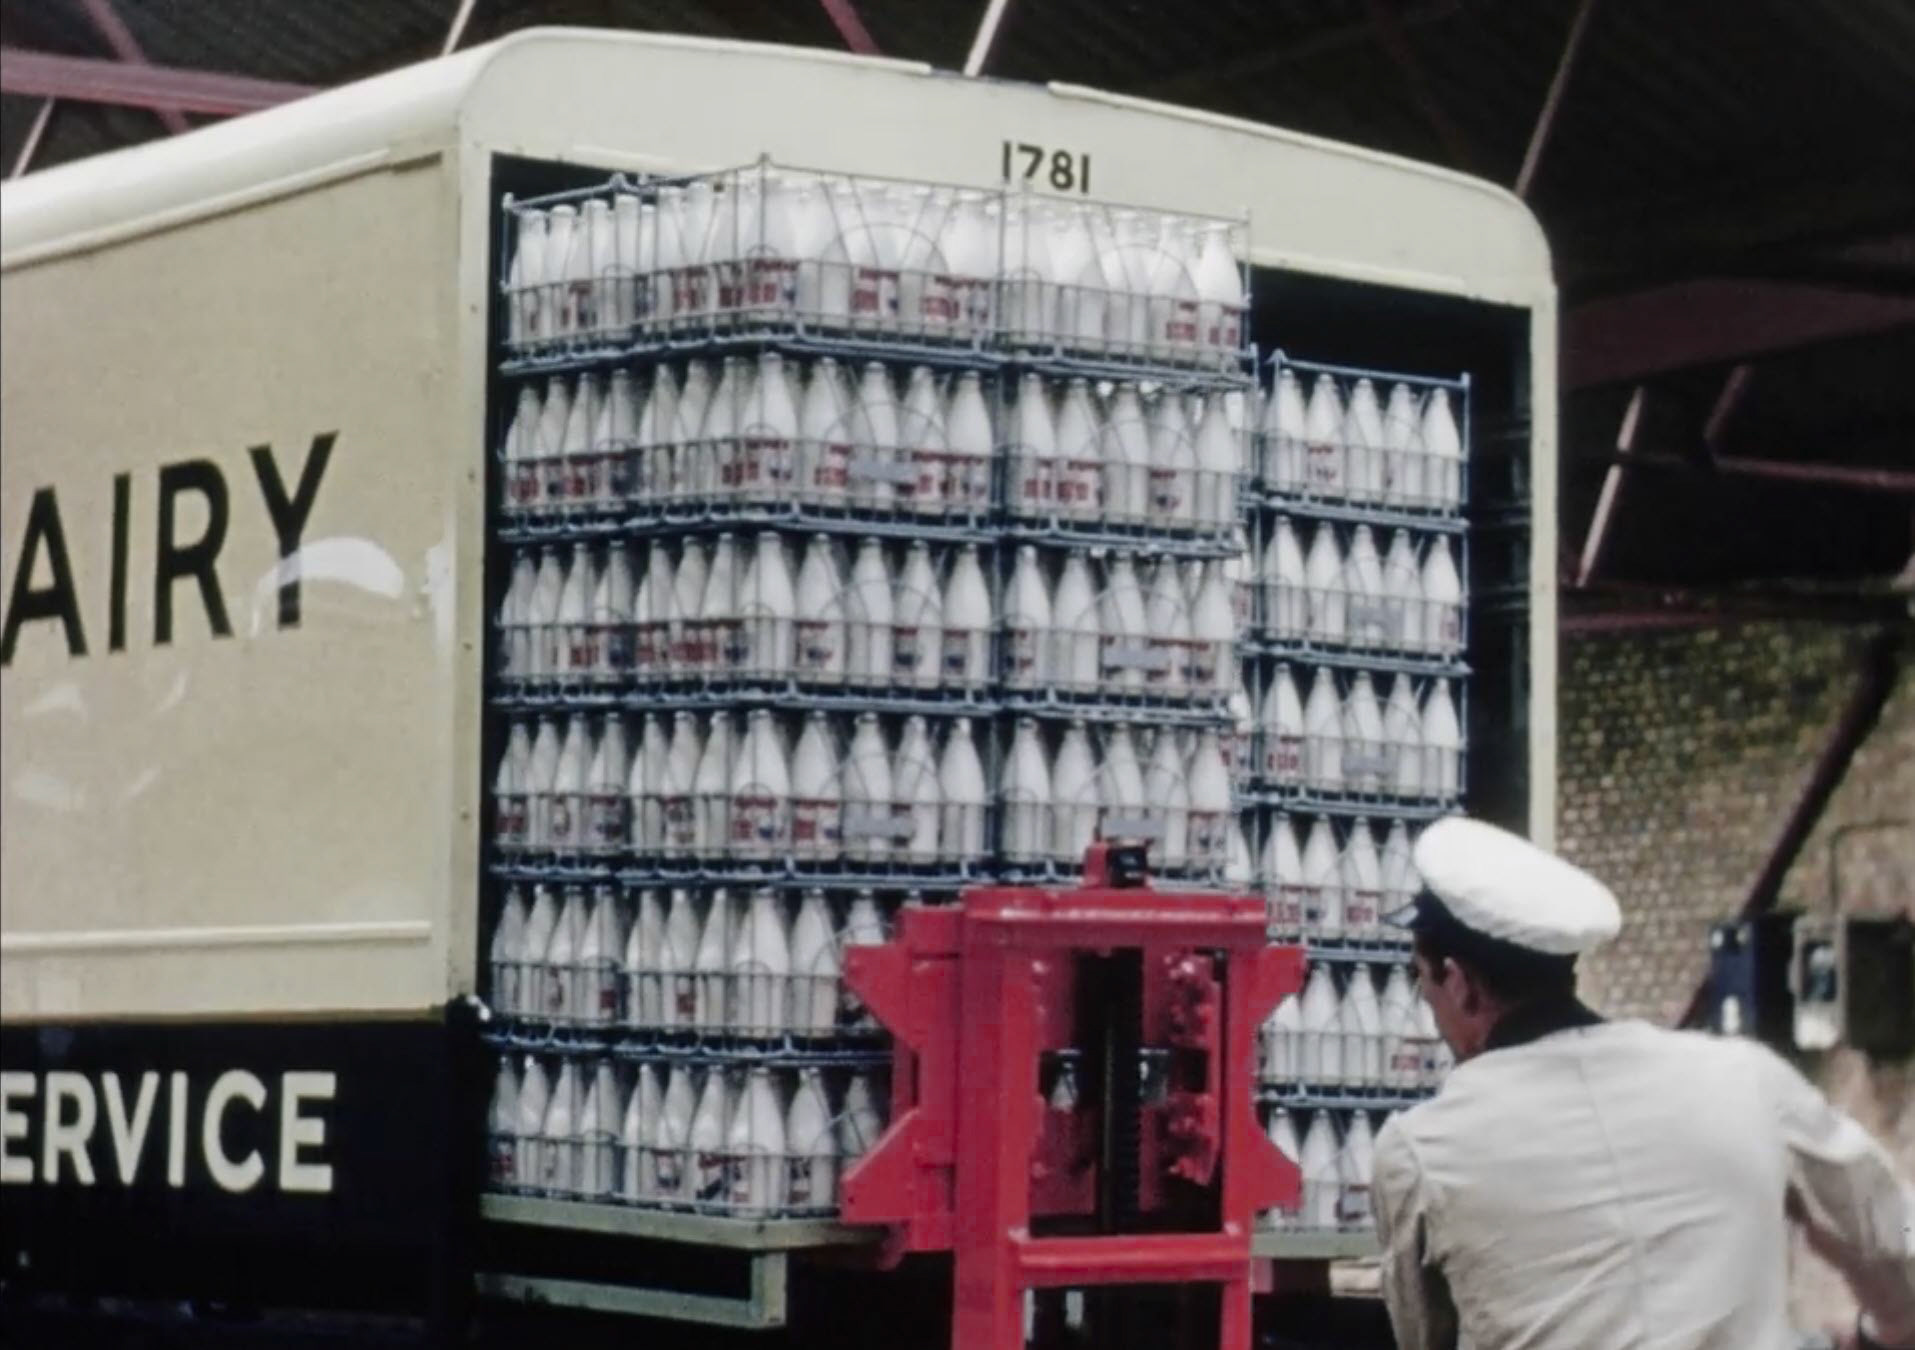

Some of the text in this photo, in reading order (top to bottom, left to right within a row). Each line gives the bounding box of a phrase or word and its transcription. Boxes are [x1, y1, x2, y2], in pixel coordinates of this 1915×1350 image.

[1002, 140, 1090, 194] 1781
[0, 430, 340, 667] AIRY
[0, 1069, 337, 1192] ERVICE
